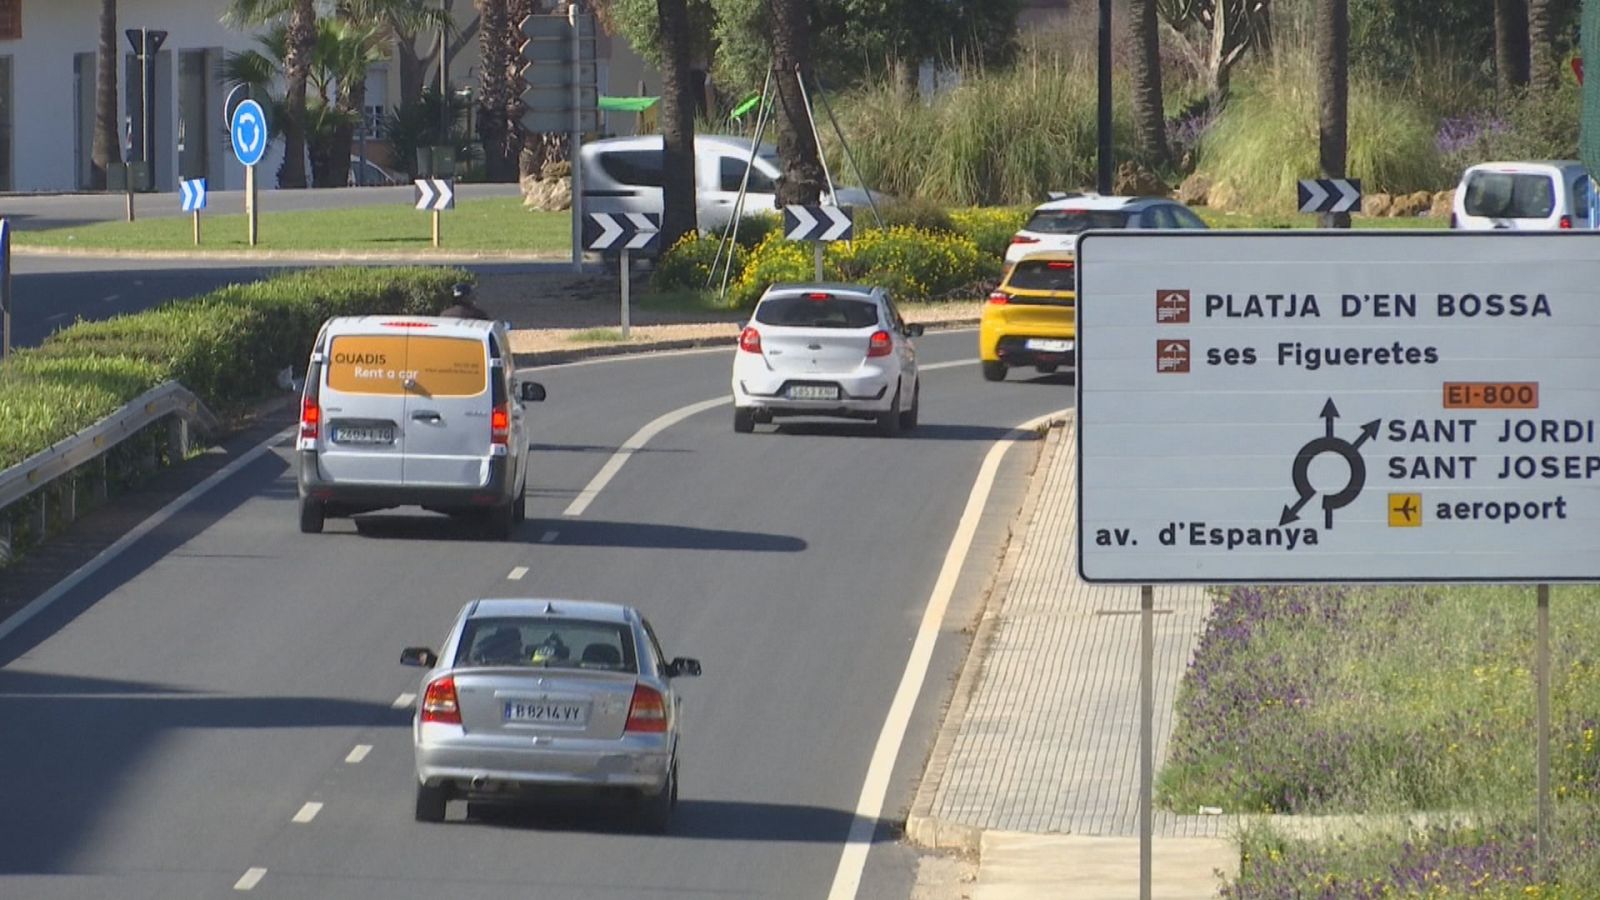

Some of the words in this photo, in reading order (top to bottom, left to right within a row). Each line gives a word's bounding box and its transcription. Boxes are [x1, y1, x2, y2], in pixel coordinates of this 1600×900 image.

[1205, 294, 1320, 317] PLATJA
[1341, 294, 1416, 317] D'EN
[1437, 294, 1551, 317] BOSSA
[335, 352, 386, 364] QUADIS
[1206, 347, 1257, 366] ses
[1278, 342, 1439, 370] Figueretes
[355, 366, 383, 378] Rent
[387, 370, 395, 379] a
[399, 370, 418, 380] car
[1449, 385, 1533, 404] EI-800
[1388, 419, 1476, 442] SANT
[1498, 419, 1594, 442] JORDI
[1388, 456, 1477, 479] SANT
[1498, 456, 1600, 479] JOSEP
[1436, 496, 1567, 521] aeroport
[1095, 528, 1138, 546] av.
[1158, 523, 1319, 550] d'Espanya
[528, 704, 560, 719] 8214
[564, 706, 580, 720] VY
